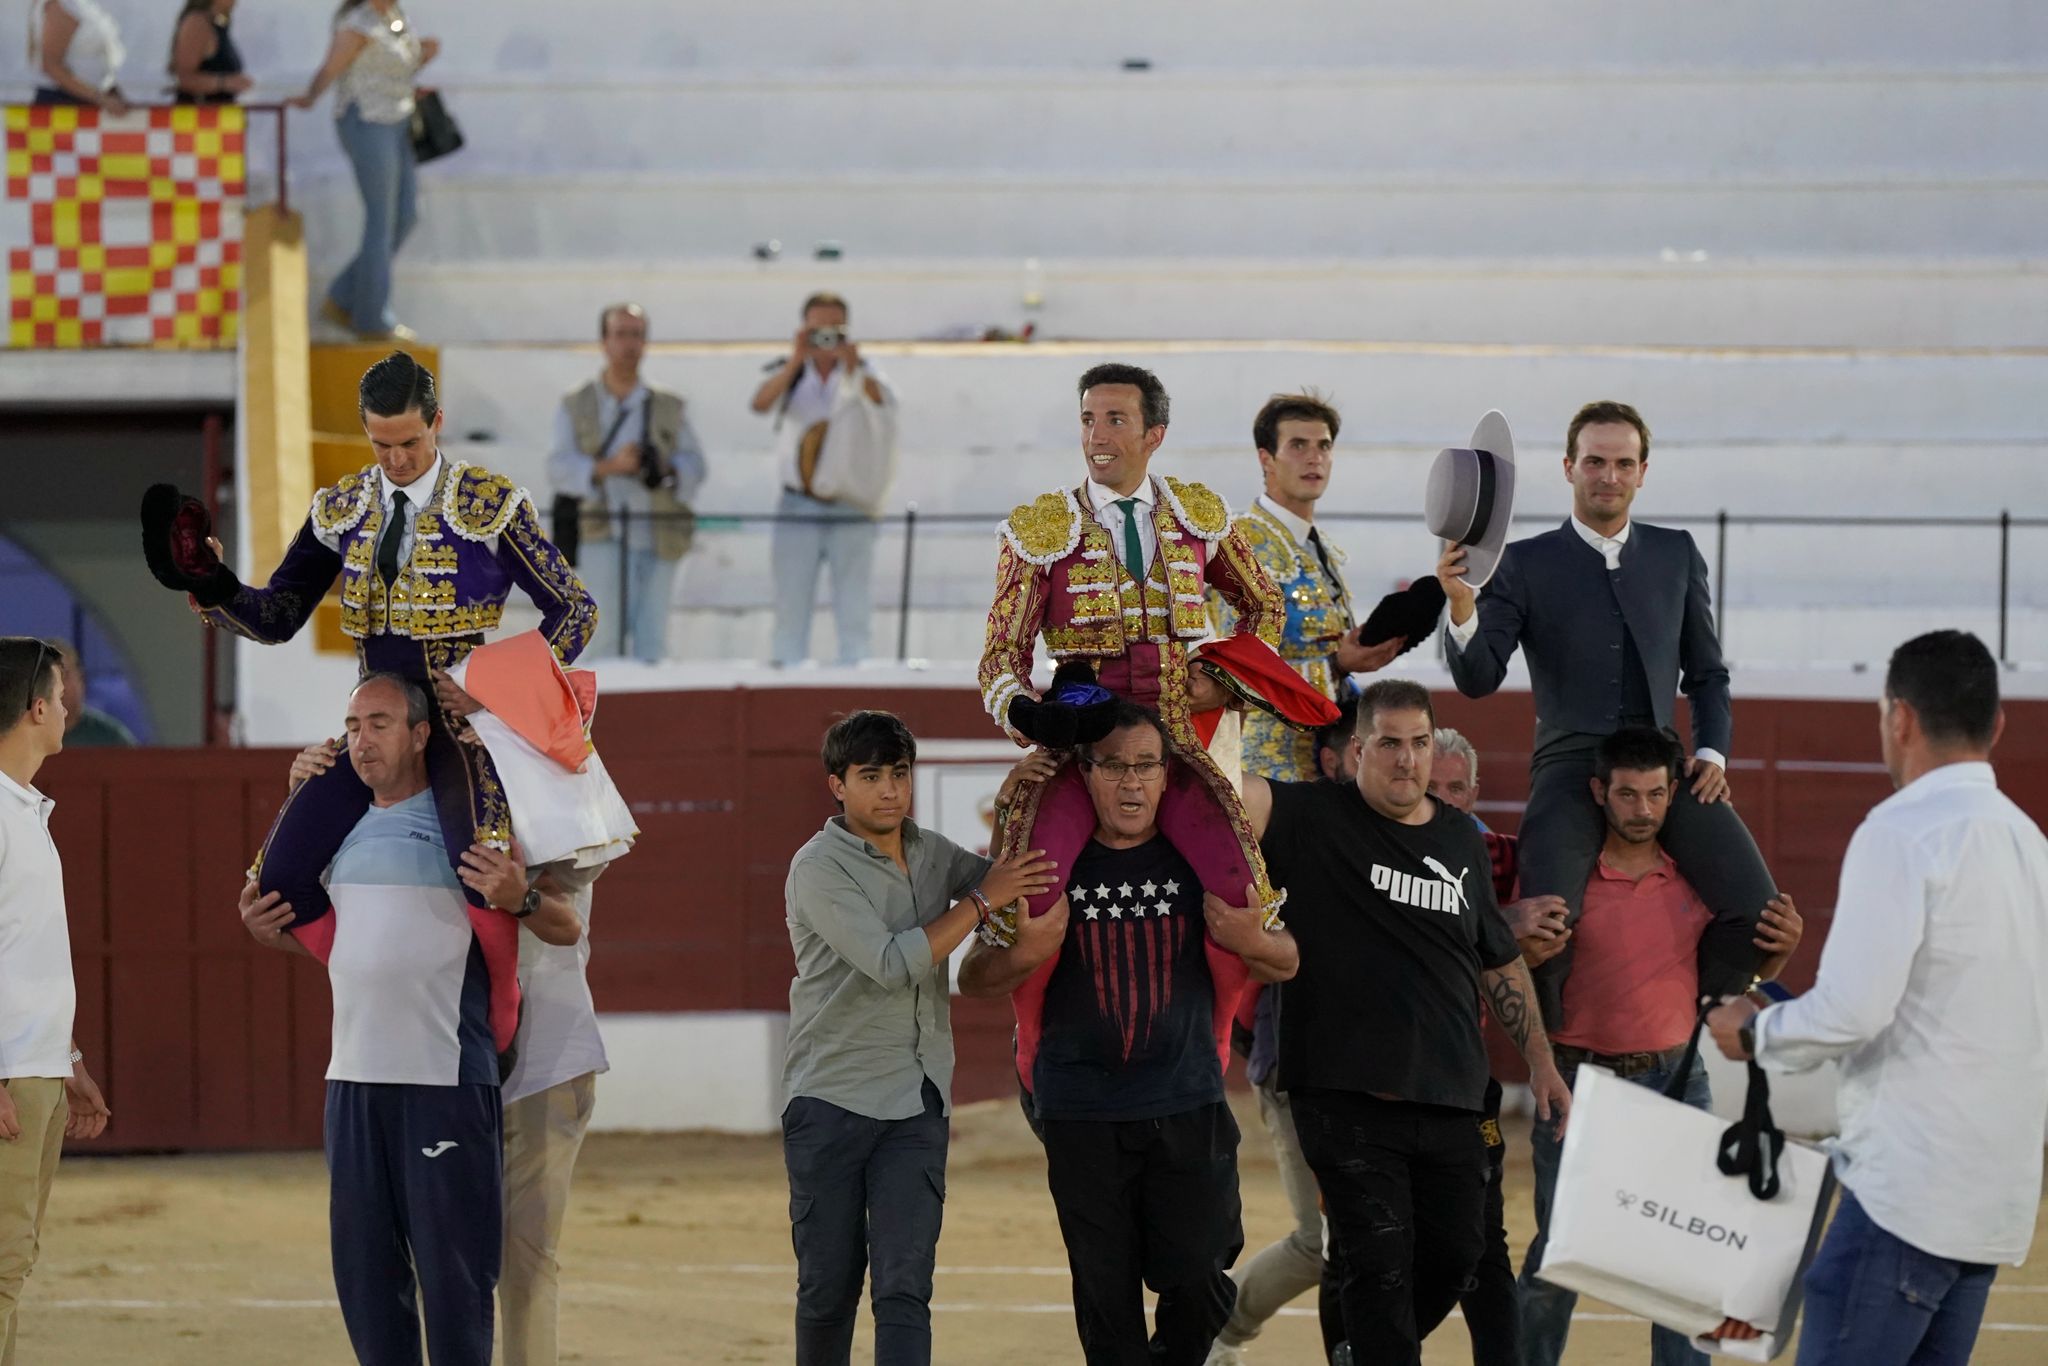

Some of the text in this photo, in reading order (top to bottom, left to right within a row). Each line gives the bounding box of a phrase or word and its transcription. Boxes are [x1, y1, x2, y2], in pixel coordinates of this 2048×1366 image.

[409, 831, 430, 841] FILA
[1370, 863, 1460, 915] PUMA
[1640, 1200, 1748, 1250] SILBON
